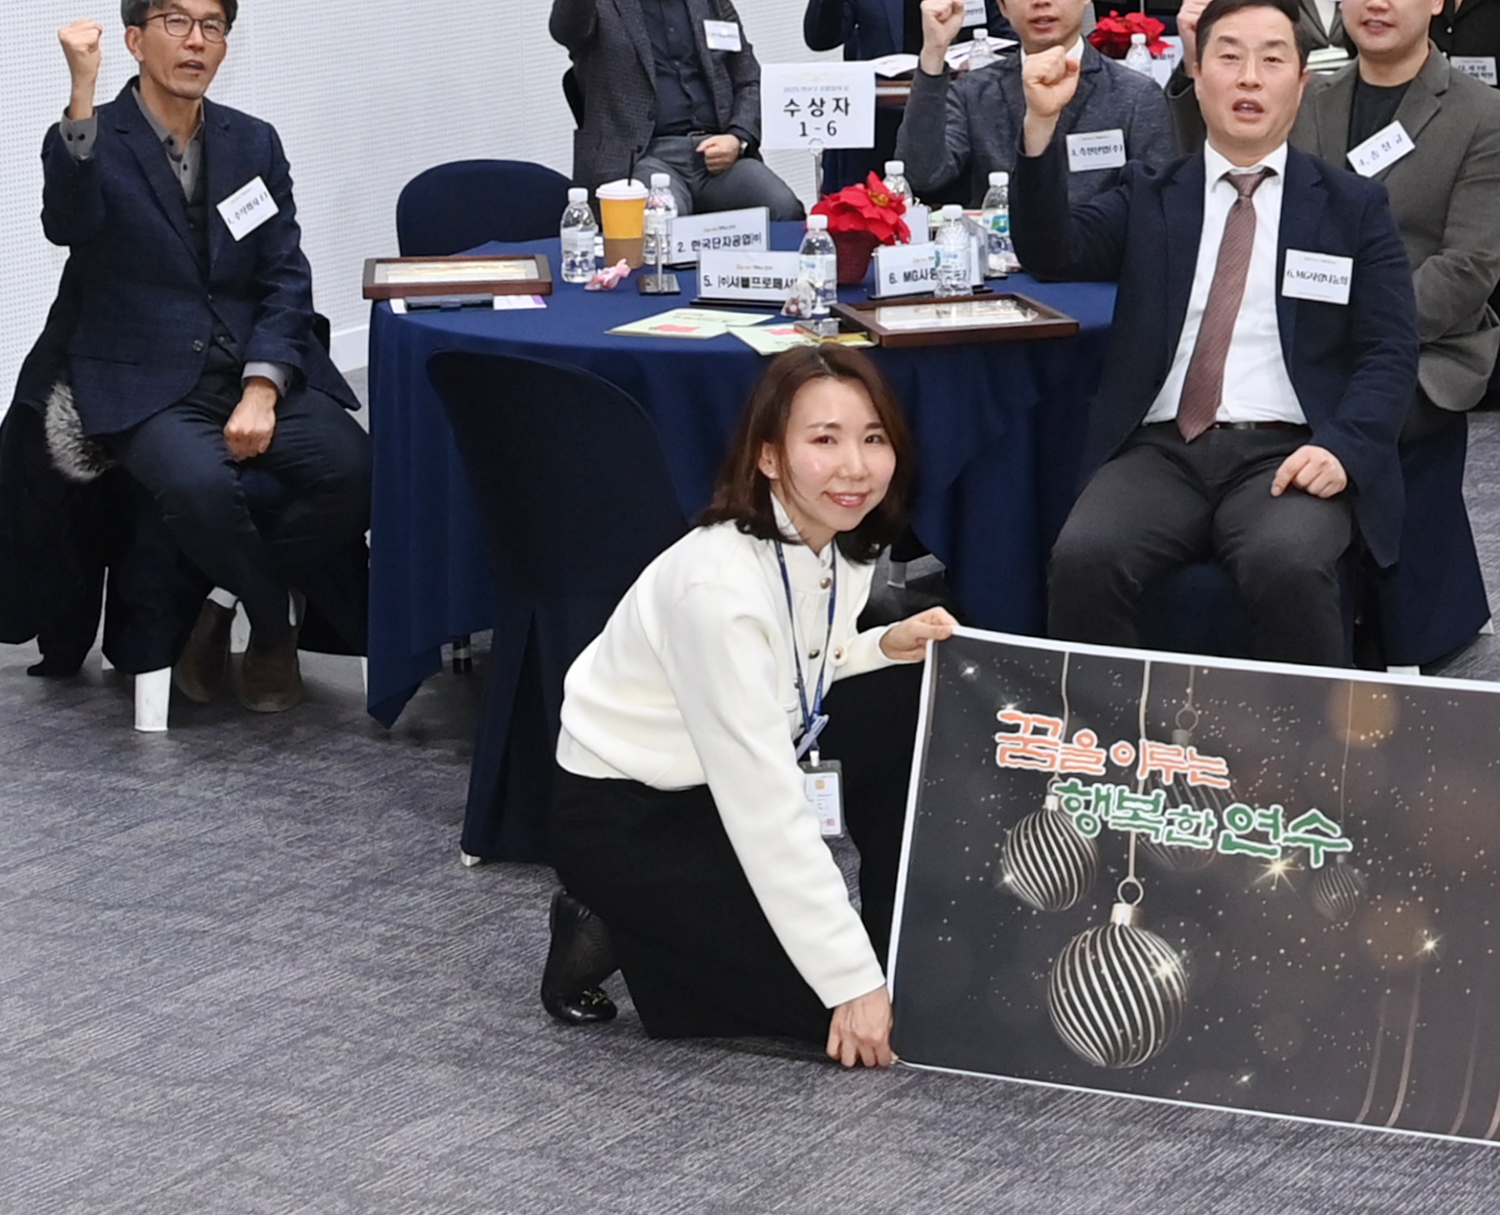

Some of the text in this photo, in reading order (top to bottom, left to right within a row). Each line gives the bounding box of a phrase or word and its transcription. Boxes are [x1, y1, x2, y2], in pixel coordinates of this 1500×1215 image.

[677, 241, 686, 253] 2.
[703, 275, 713, 287] 5.
[996, 710, 1230, 787] 꿈을 이루는
[1053, 778, 1352, 868] 행복한 연수
